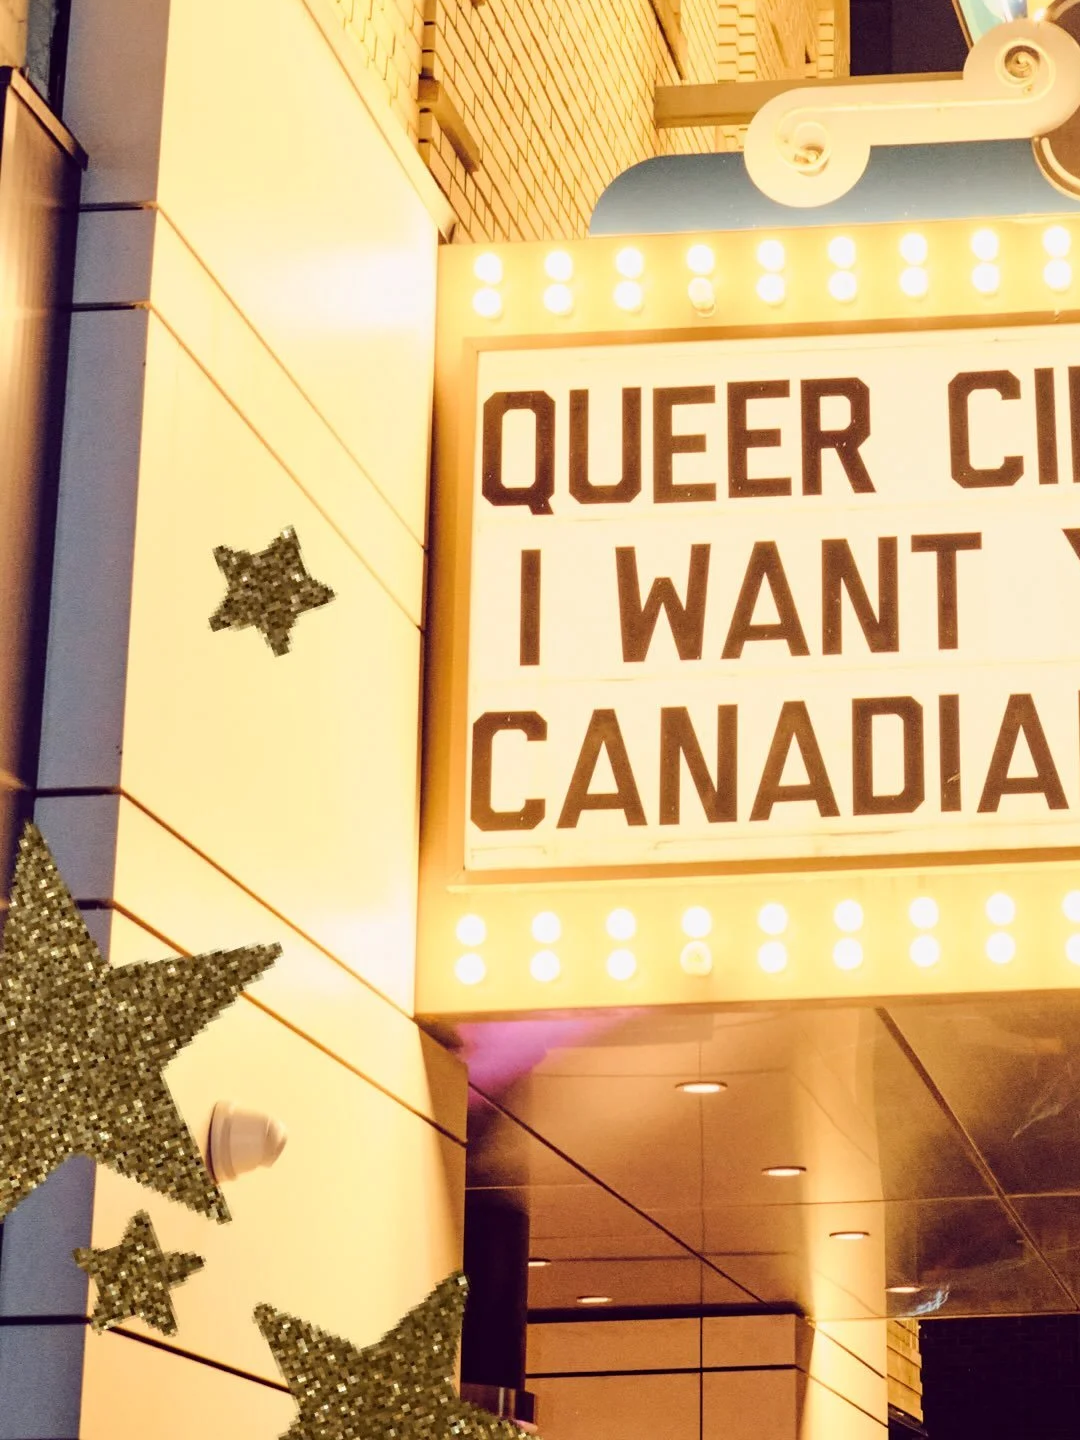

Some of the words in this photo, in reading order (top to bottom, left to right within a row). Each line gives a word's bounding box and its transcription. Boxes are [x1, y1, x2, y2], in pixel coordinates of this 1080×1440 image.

[481, 377, 876, 515] QUEER
[519, 549, 541, 666] I
[615, 532, 982, 663] WANT
